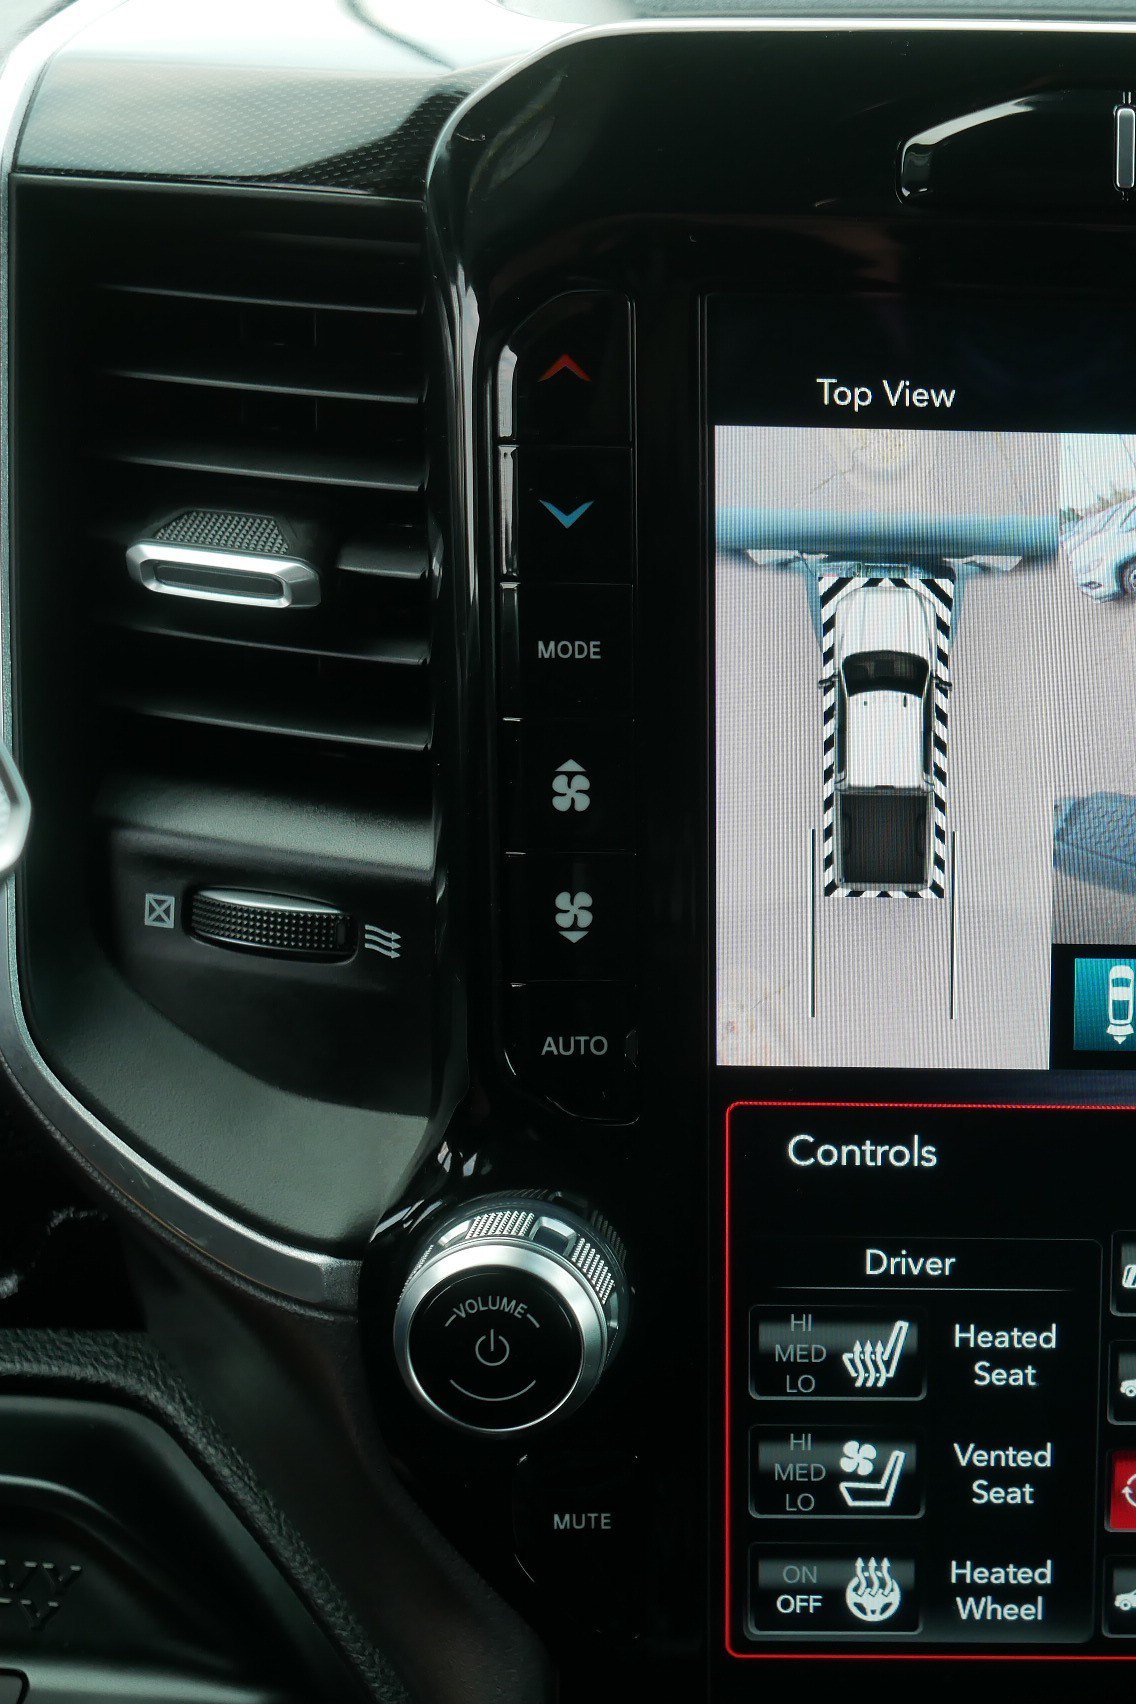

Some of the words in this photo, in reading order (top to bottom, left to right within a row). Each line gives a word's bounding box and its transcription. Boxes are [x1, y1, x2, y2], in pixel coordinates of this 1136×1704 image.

[815, 378, 873, 411] Top
[882, 379, 956, 408] View
[537, 640, 602, 660] MODE
[540, 1035, 608, 1056] AUTO
[787, 1134, 937, 1167] Controls
[865, 1248, 956, 1276] Driver
[453, 1294, 527, 1319] VOLUME
[790, 1313, 812, 1332] HI
[954, 1322, 1057, 1349] Heated
[775, 1344, 827, 1363] MED
[786, 1374, 816, 1393] LO
[973, 1360, 1037, 1387] Seat
[789, 1432, 812, 1451] HI
[953, 1441, 1052, 1468] Vented
[774, 1463, 827, 1482] MED
[785, 1492, 815, 1512] LO
[971, 1479, 1035, 1505] Seat
[553, 1512, 612, 1530] MUTE
[782, 1564, 818, 1584] ON
[950, 1559, 1052, 1585] Heated
[776, 1594, 823, 1614] OFF
[955, 1595, 1043, 1621] Wheel
